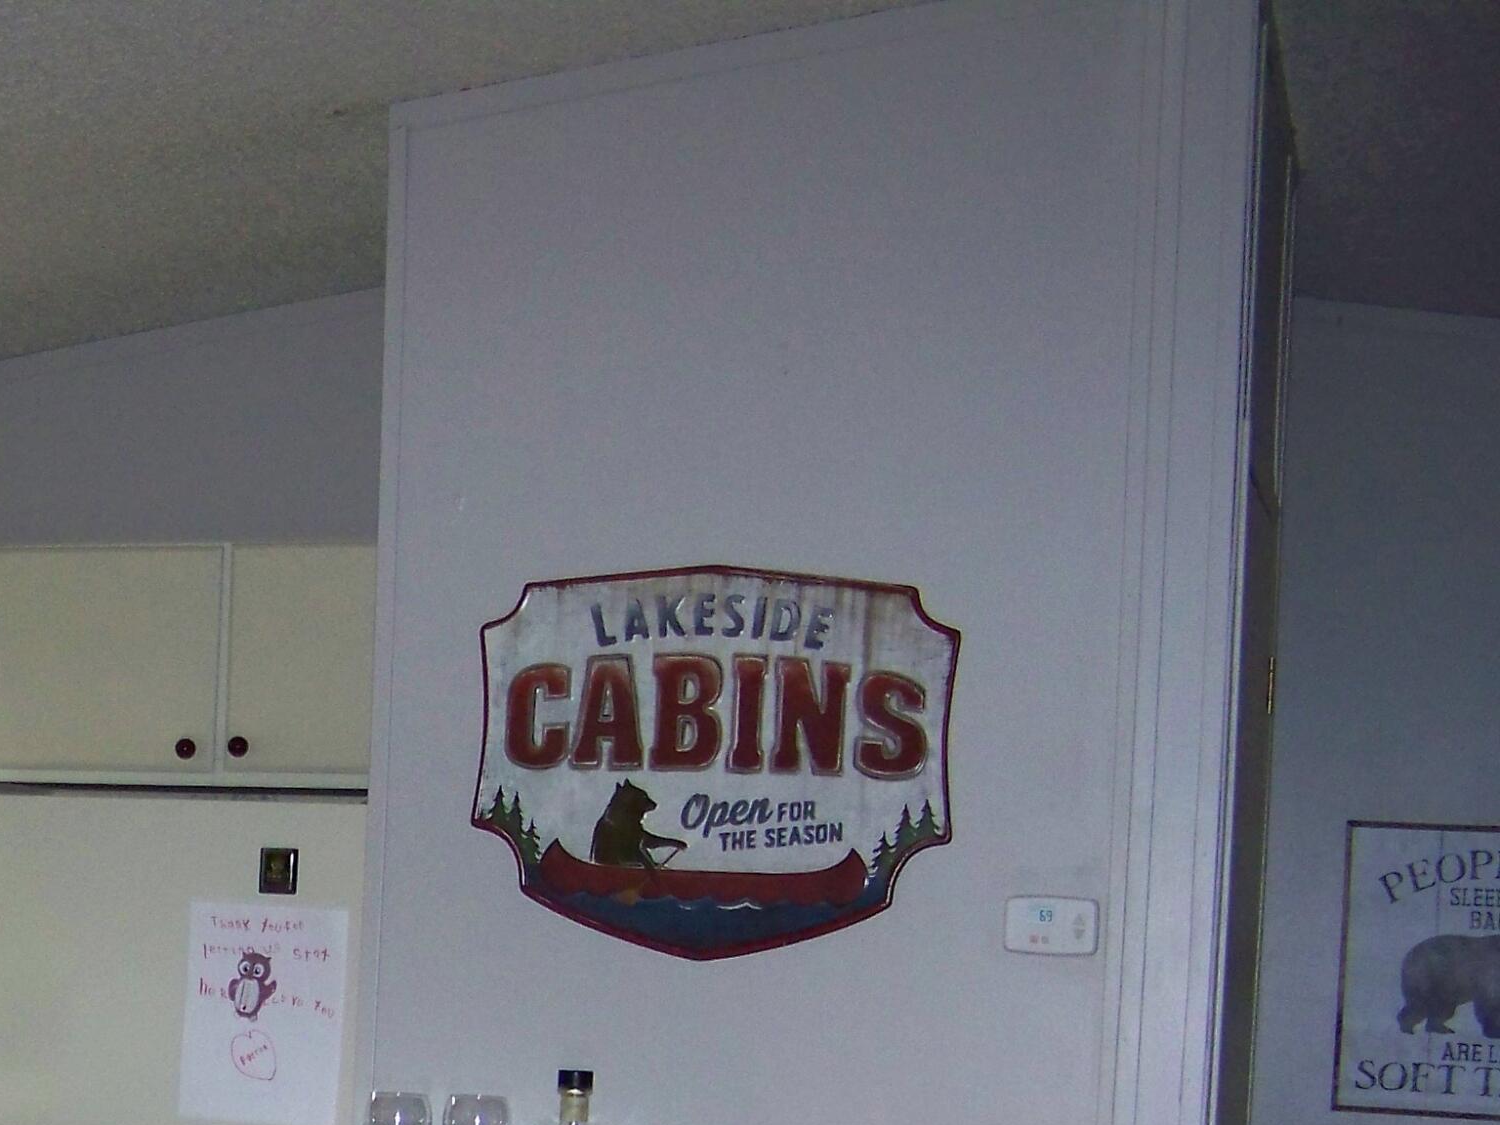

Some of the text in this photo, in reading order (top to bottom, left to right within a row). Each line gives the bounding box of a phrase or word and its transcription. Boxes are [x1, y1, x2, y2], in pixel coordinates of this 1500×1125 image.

[590, 593, 836, 650] LAKESIDE
[504, 653, 928, 781] CABINS
[681, 793, 816, 838] Open FOR
[719, 822, 843, 851] THE SEASON
[1378, 849, 1500, 904] PEOP
[1469, 910, 1500, 931] BA
[1441, 1042, 1482, 1062] ARE
[1355, 1059, 1466, 1096] SOFT
